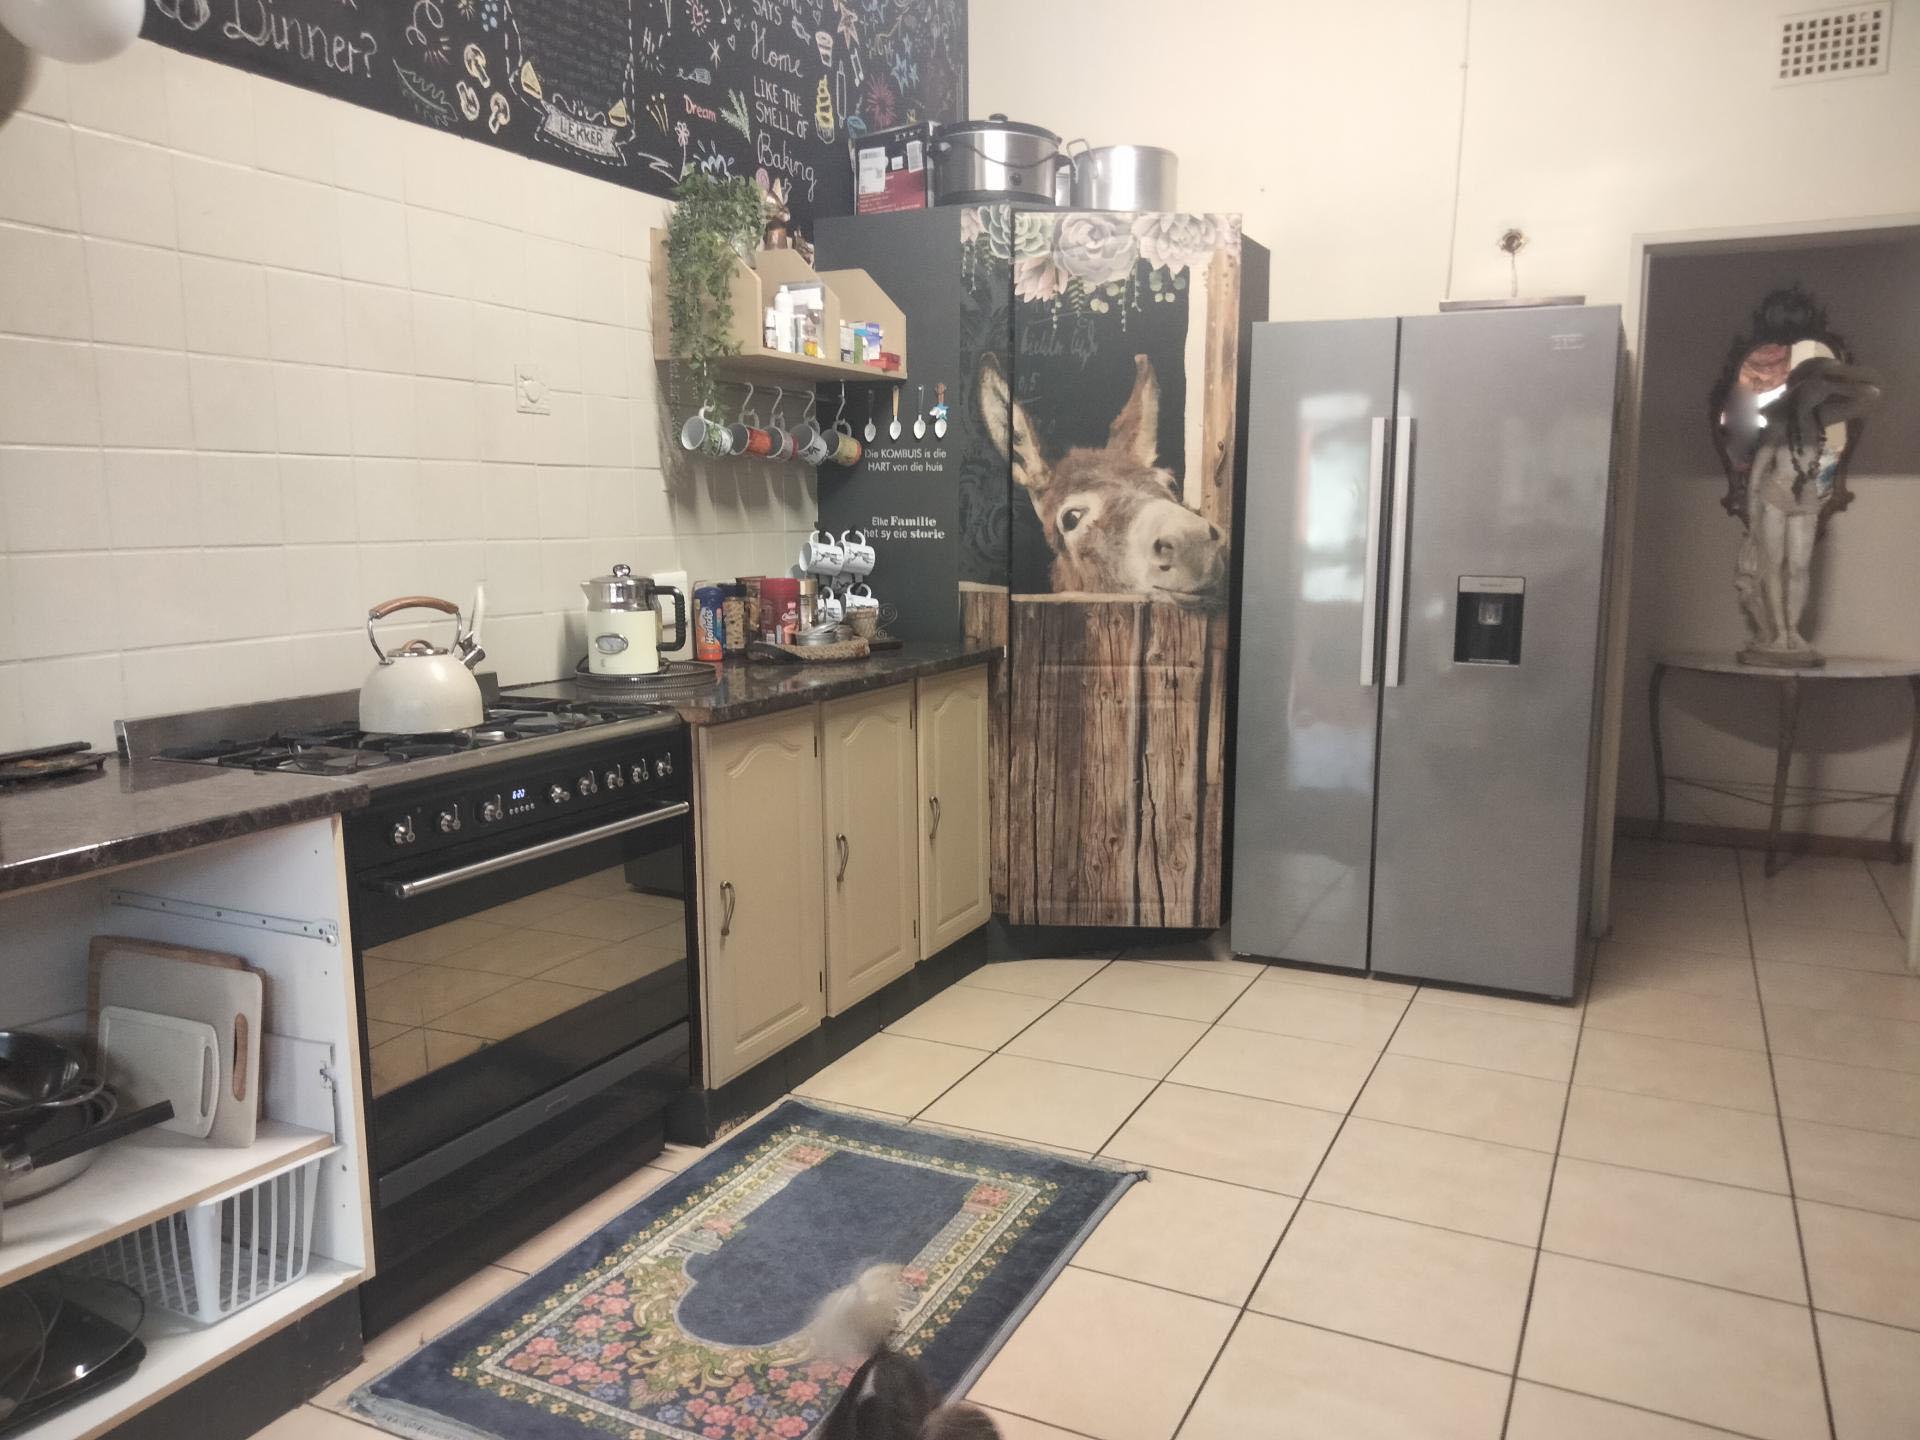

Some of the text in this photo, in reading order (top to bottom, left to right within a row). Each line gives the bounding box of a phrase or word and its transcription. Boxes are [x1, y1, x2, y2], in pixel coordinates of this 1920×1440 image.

[751, 20, 803, 78] Home
[683, 93, 717, 122] Dream
[753, 75, 803, 117] LIKE THE
[755, 101, 809, 140] SMELL OF
[757, 129, 818, 202] Baking
[867, 461, 891, 472] HART
[880, 448, 922, 460] KOMBUIS
[880, 530, 891, 541] sy
[910, 528, 945, 540] storie
